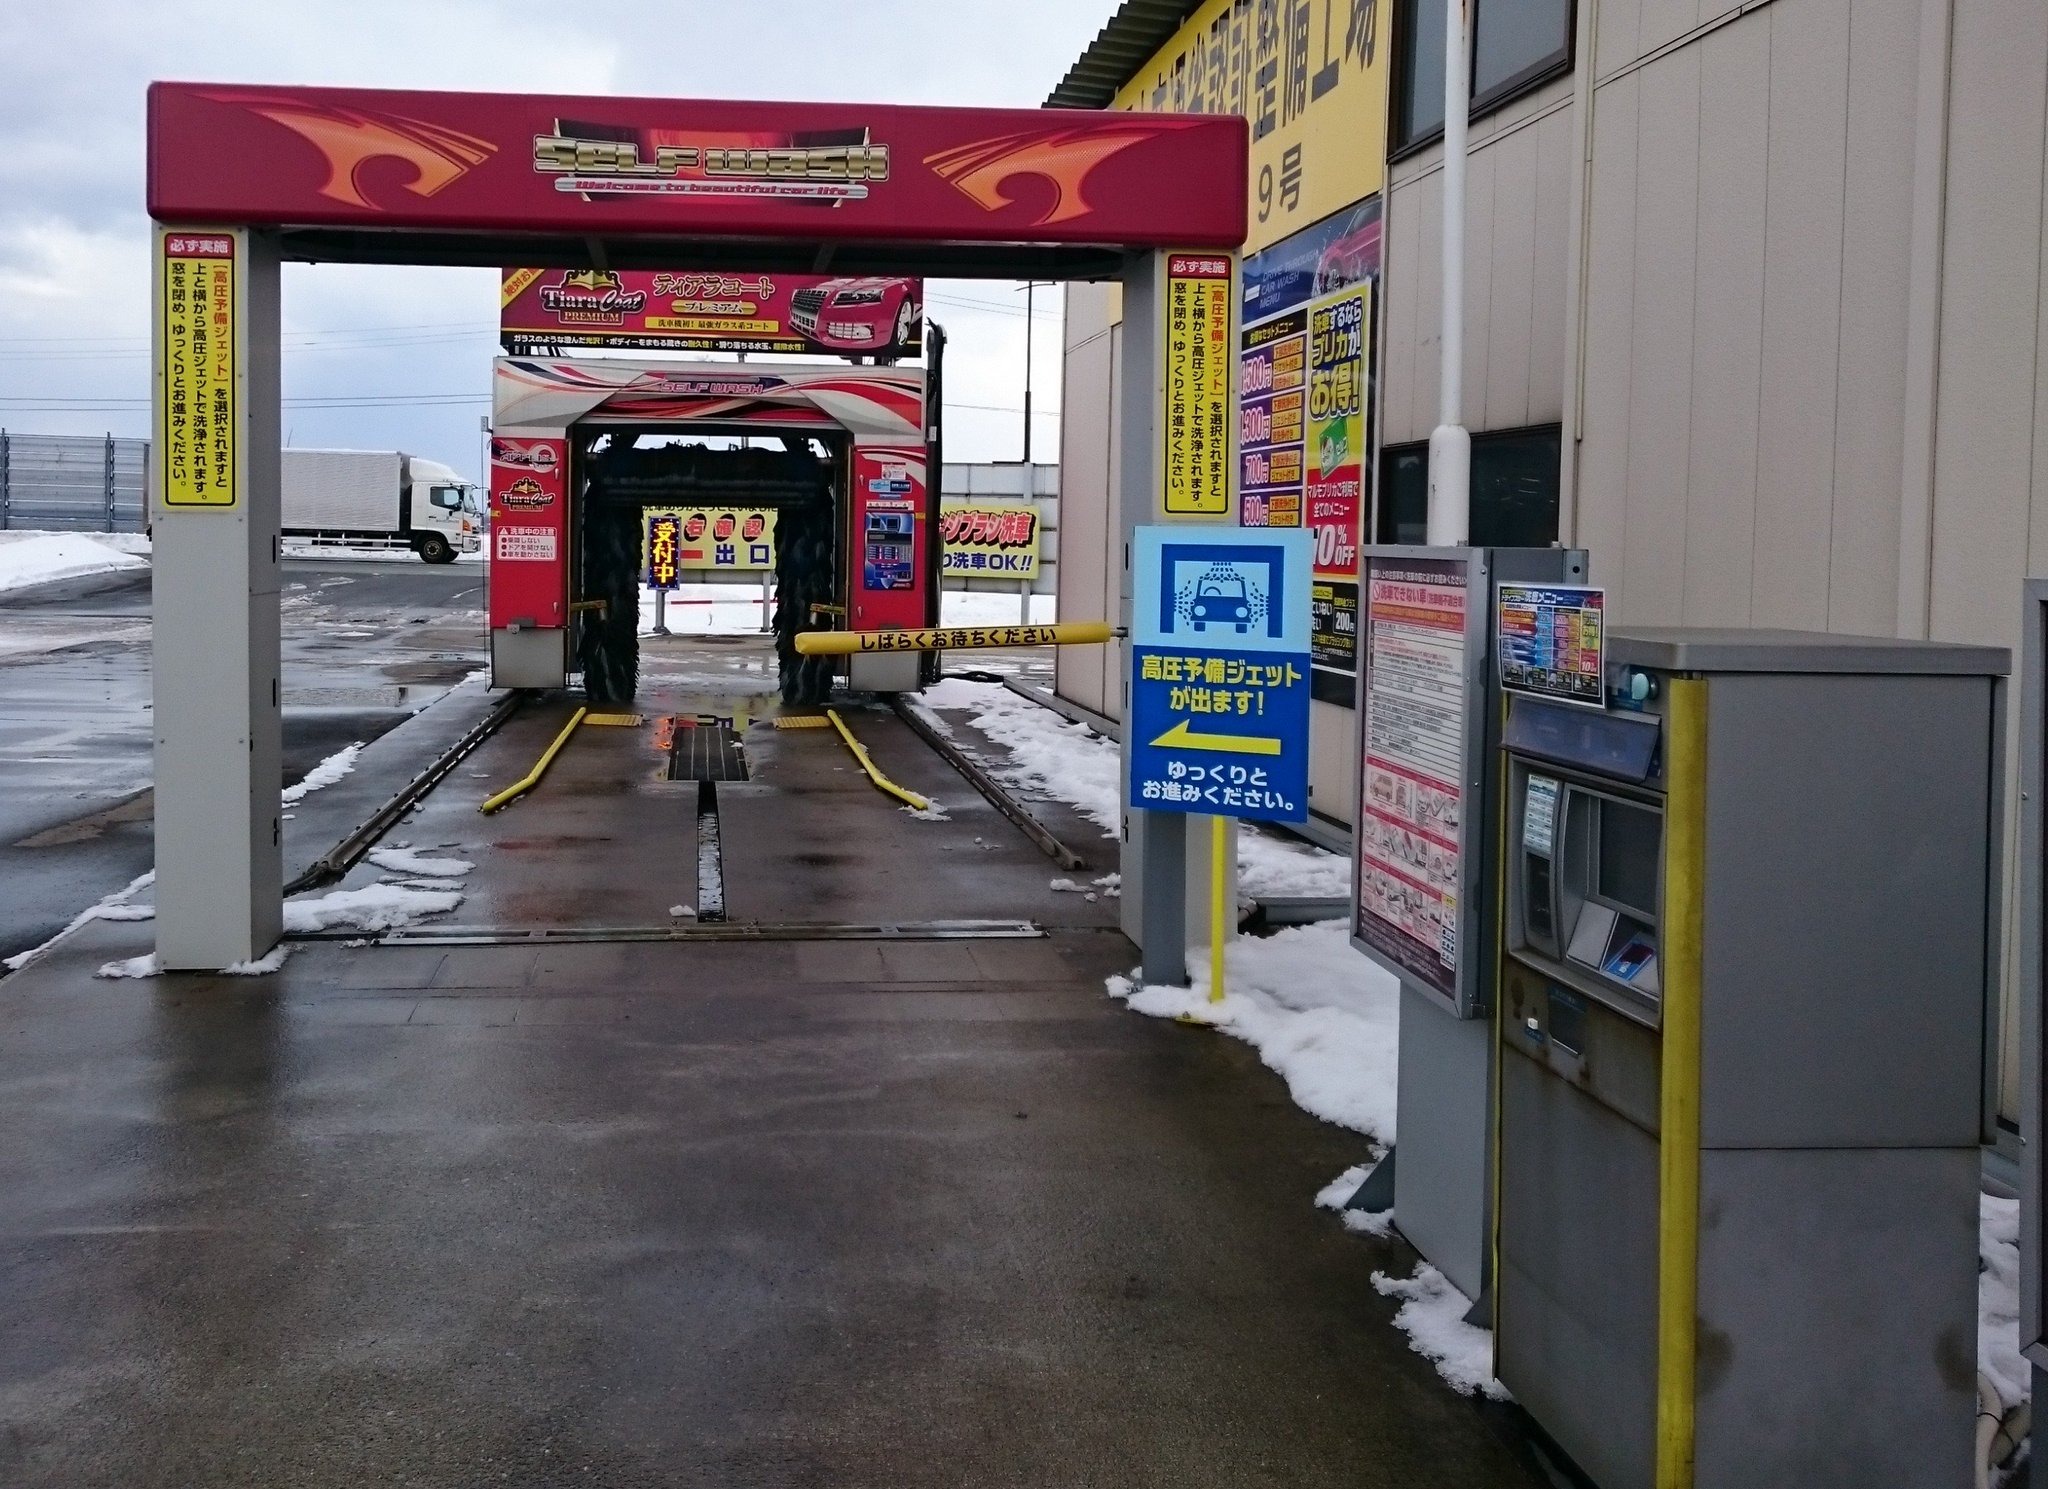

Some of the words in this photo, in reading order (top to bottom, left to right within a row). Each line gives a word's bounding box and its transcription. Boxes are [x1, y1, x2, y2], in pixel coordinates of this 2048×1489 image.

[575, 180, 660, 192] Welcome
[666, 182, 686, 192] to
[690, 182, 777, 195] beautiful
[780, 187, 813, 195] car
[817, 186, 849, 196] life
[170, 240, 228, 253] 必ず実施
[1173, 261, 1225, 273] 必ず実施
[652, 274, 775, 300] ティアラコート
[1261, 281, 1276, 296] CAR
[1277, 270, 1300, 289] WASH
[544, 289, 598, 309] Tiara
[599, 289, 641, 312] Coat
[685, 302, 743, 313] プレミアム
[1260, 292, 1281, 309] MENU
[564, 312, 619, 322] PREMIUM
[1314, 298, 1361, 335] 洗車するなら
[1313, 325, 1361, 367] プリカが
[172, 262, 187, 486] 窓を閉め、ゆっくりとお進みください。
[193, 262, 207, 500] 上と横から高圧ジェットで洗浄されます。
[661, 382, 709, 393] SELF
[710, 383, 764, 395] WASH
[1171, 282, 1186, 495] 窓を閉め、ゆっくりとお進みください。
[1190, 283, 1205, 508] 上と横から高圧ジェットで洗浄されます。
[1311, 358, 1360, 418] お得!
[1245, 453, 1270, 485] 700円
[501, 493, 530, 503] Tiara
[1308, 481, 1359, 498] マルモプリカご利用で
[1244, 495, 1269, 526] 500円
[1313, 501, 1350, 518] 全てのメニュー
[653, 521, 676, 584] 受付中
[715, 543, 770, 565] 出口
[1335, 545, 1355, 566] OFF
[860, 623, 1058, 651] しばらくお待ちください
[1141, 655, 1302, 689] 高圧予備ジェット
[1170, 686, 1265, 716] が出ます!
[1167, 761, 1268, 787] ゆっくりと
[1142, 781, 1294, 811] お進みください。
